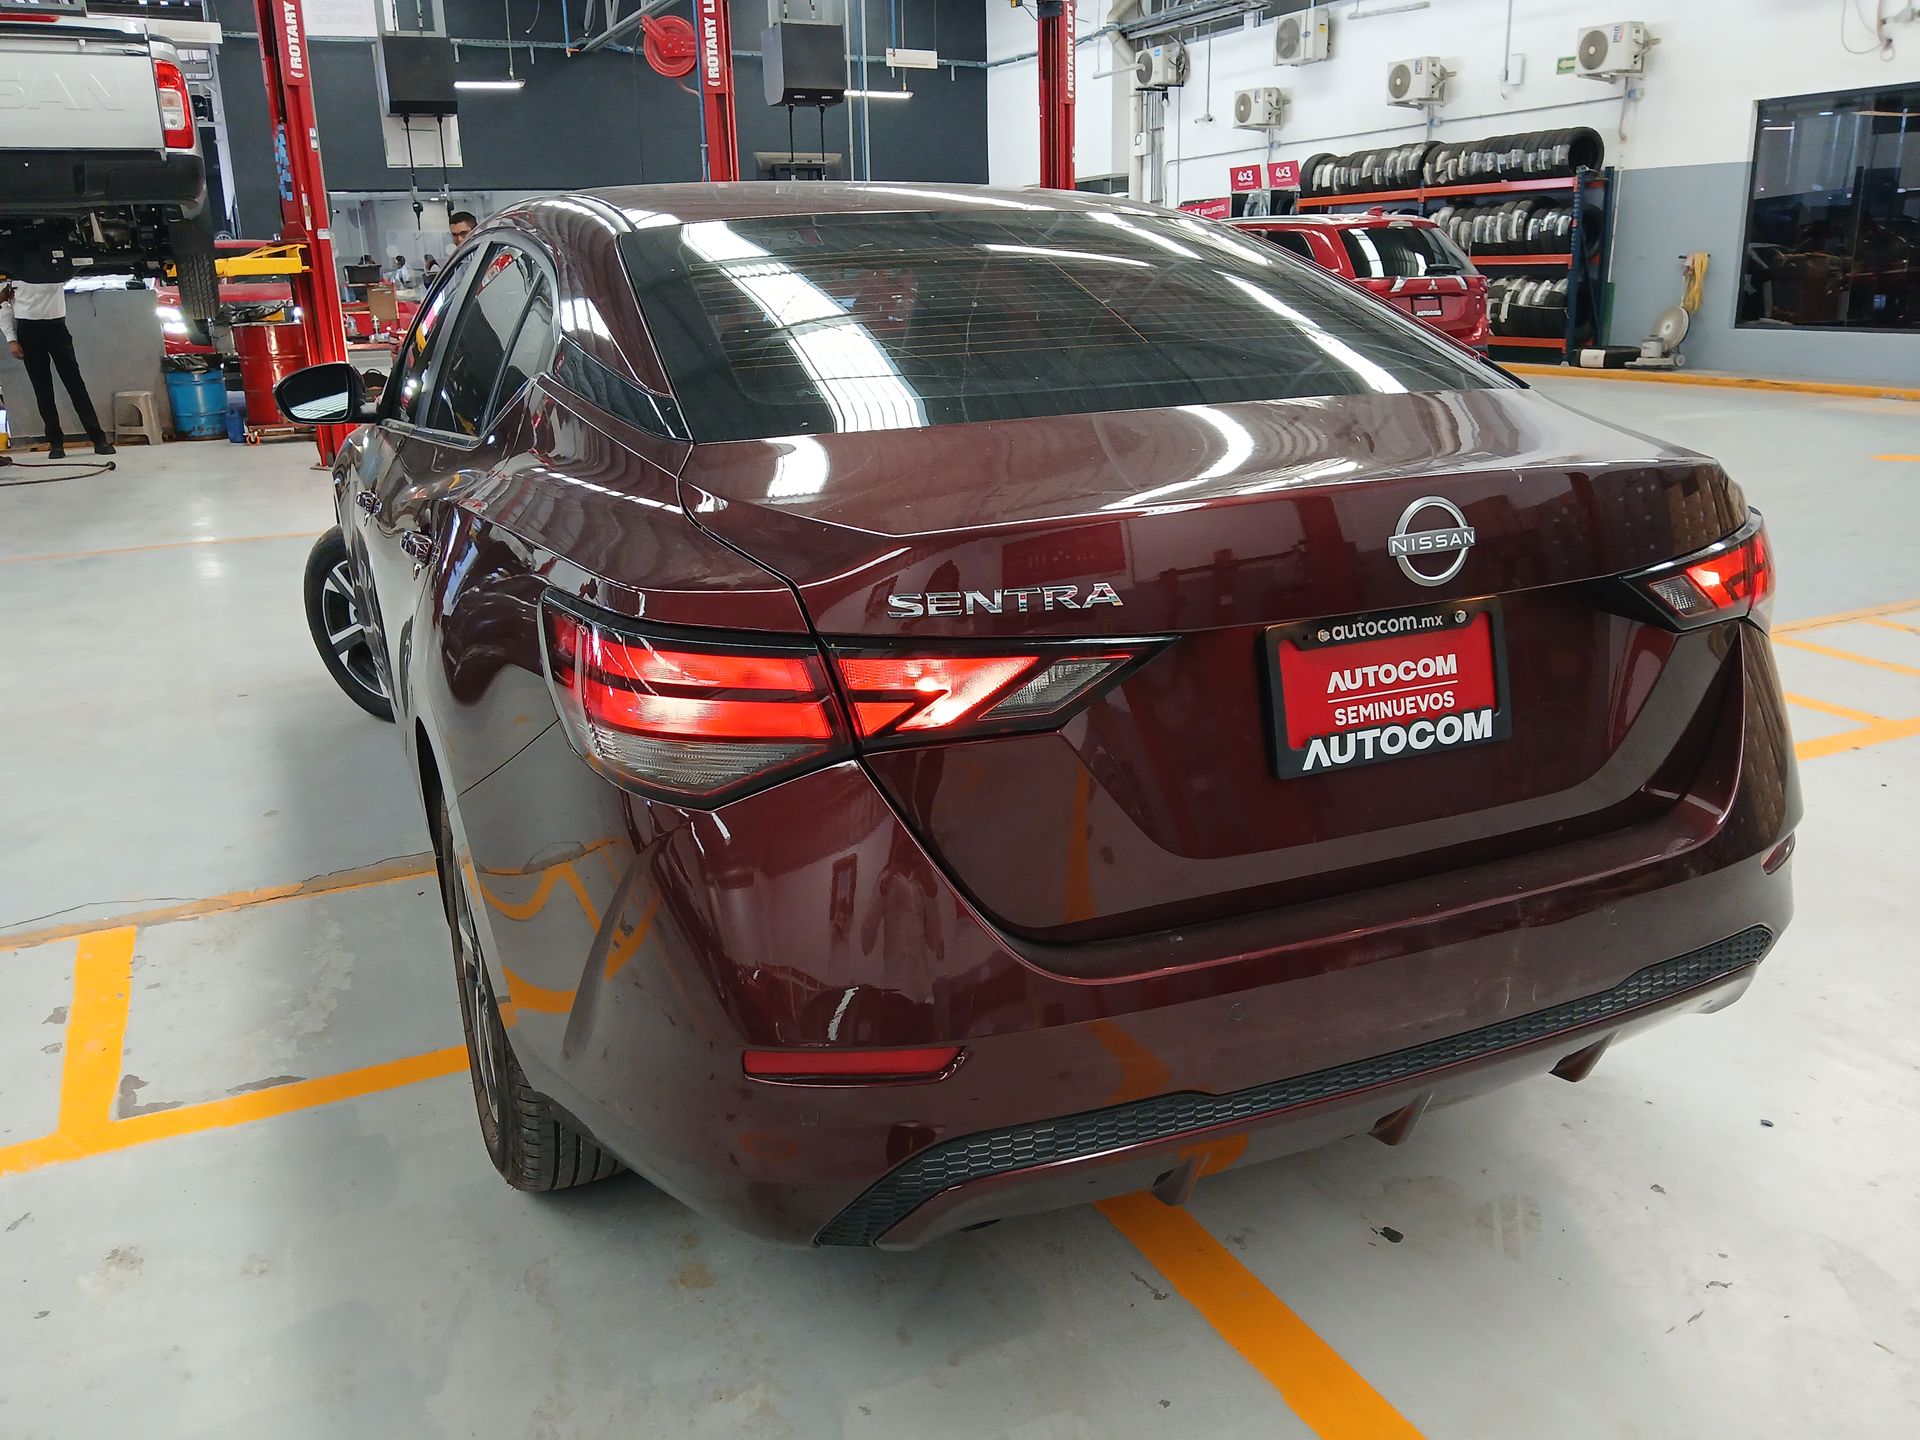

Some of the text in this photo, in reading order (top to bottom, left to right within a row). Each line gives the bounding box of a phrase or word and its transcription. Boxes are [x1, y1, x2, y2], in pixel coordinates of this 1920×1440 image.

[283, 0, 303, 69] ROTARY
[703, 16, 720, 78] ROTARY
[1066, 3, 1074, 91] ROTARY LIFT
[1391, 531, 1475, 553] NISSAN
[887, 582, 1124, 618] SENTRA
[1331, 614, 1443, 641] autocom.mx
[1327, 653, 1458, 694] AUTOCOM
[1334, 690, 1455, 726] SEMINUEVOS
[1302, 708, 1493, 771] AUTOCOM
